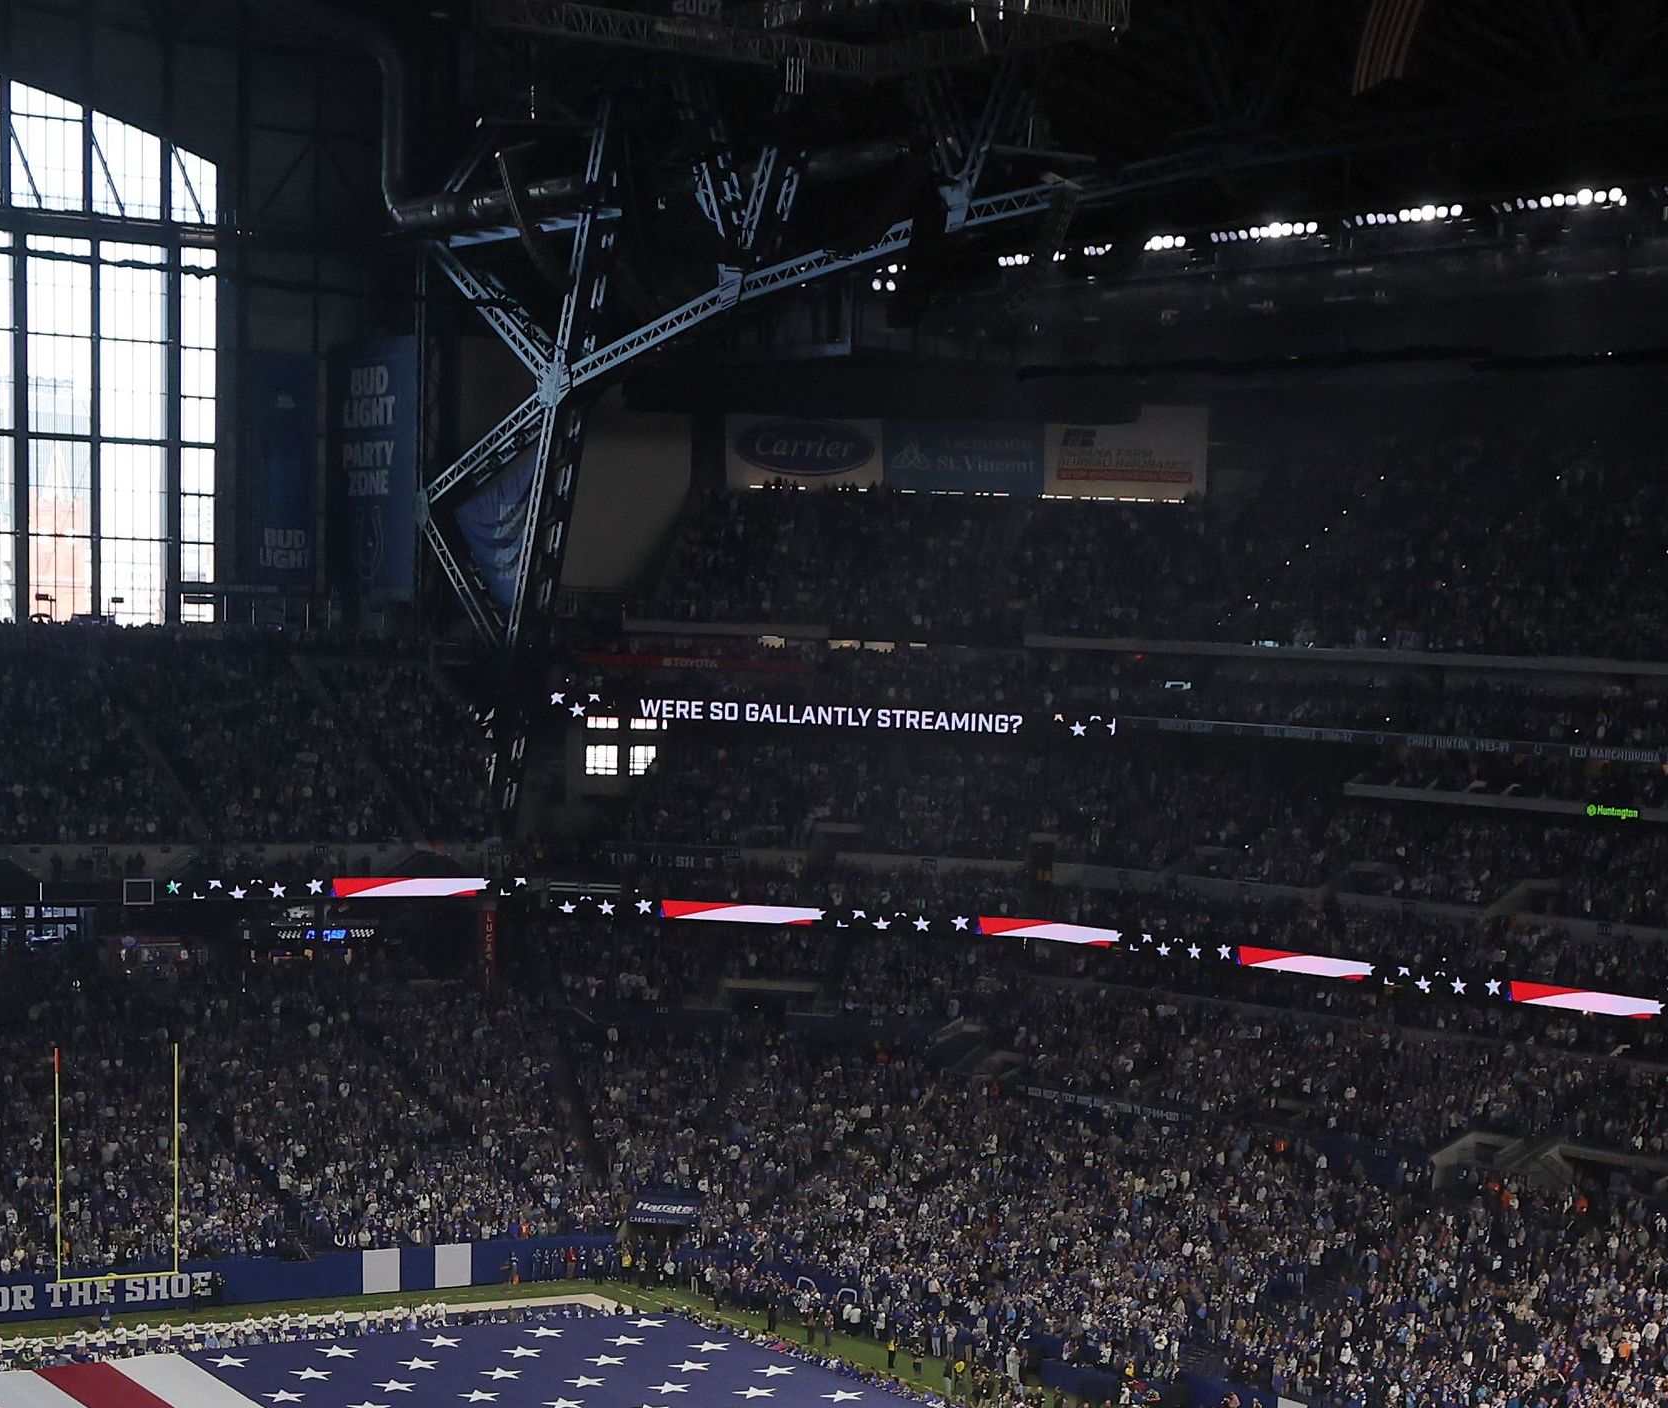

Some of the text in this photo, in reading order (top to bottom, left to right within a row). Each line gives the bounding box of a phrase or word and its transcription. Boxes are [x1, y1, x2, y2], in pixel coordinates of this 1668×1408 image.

[350, 366, 389, 396] BUD
[343, 395, 396, 428] LIGHT
[342, 440, 394, 468] PARTY
[755, 433, 855, 460] Carrier
[347, 468, 389, 496] ZONE
[264, 527, 306, 548] BUD
[259, 547, 309, 568] LIGHT
[672, 657, 719, 670] TOYOTA
[639, 698, 1023, 735] WERE SO GALLANTLY STREAMING?
[45, 1279, 116, 1309] THE
[124, 1271, 213, 1303] SHOE
